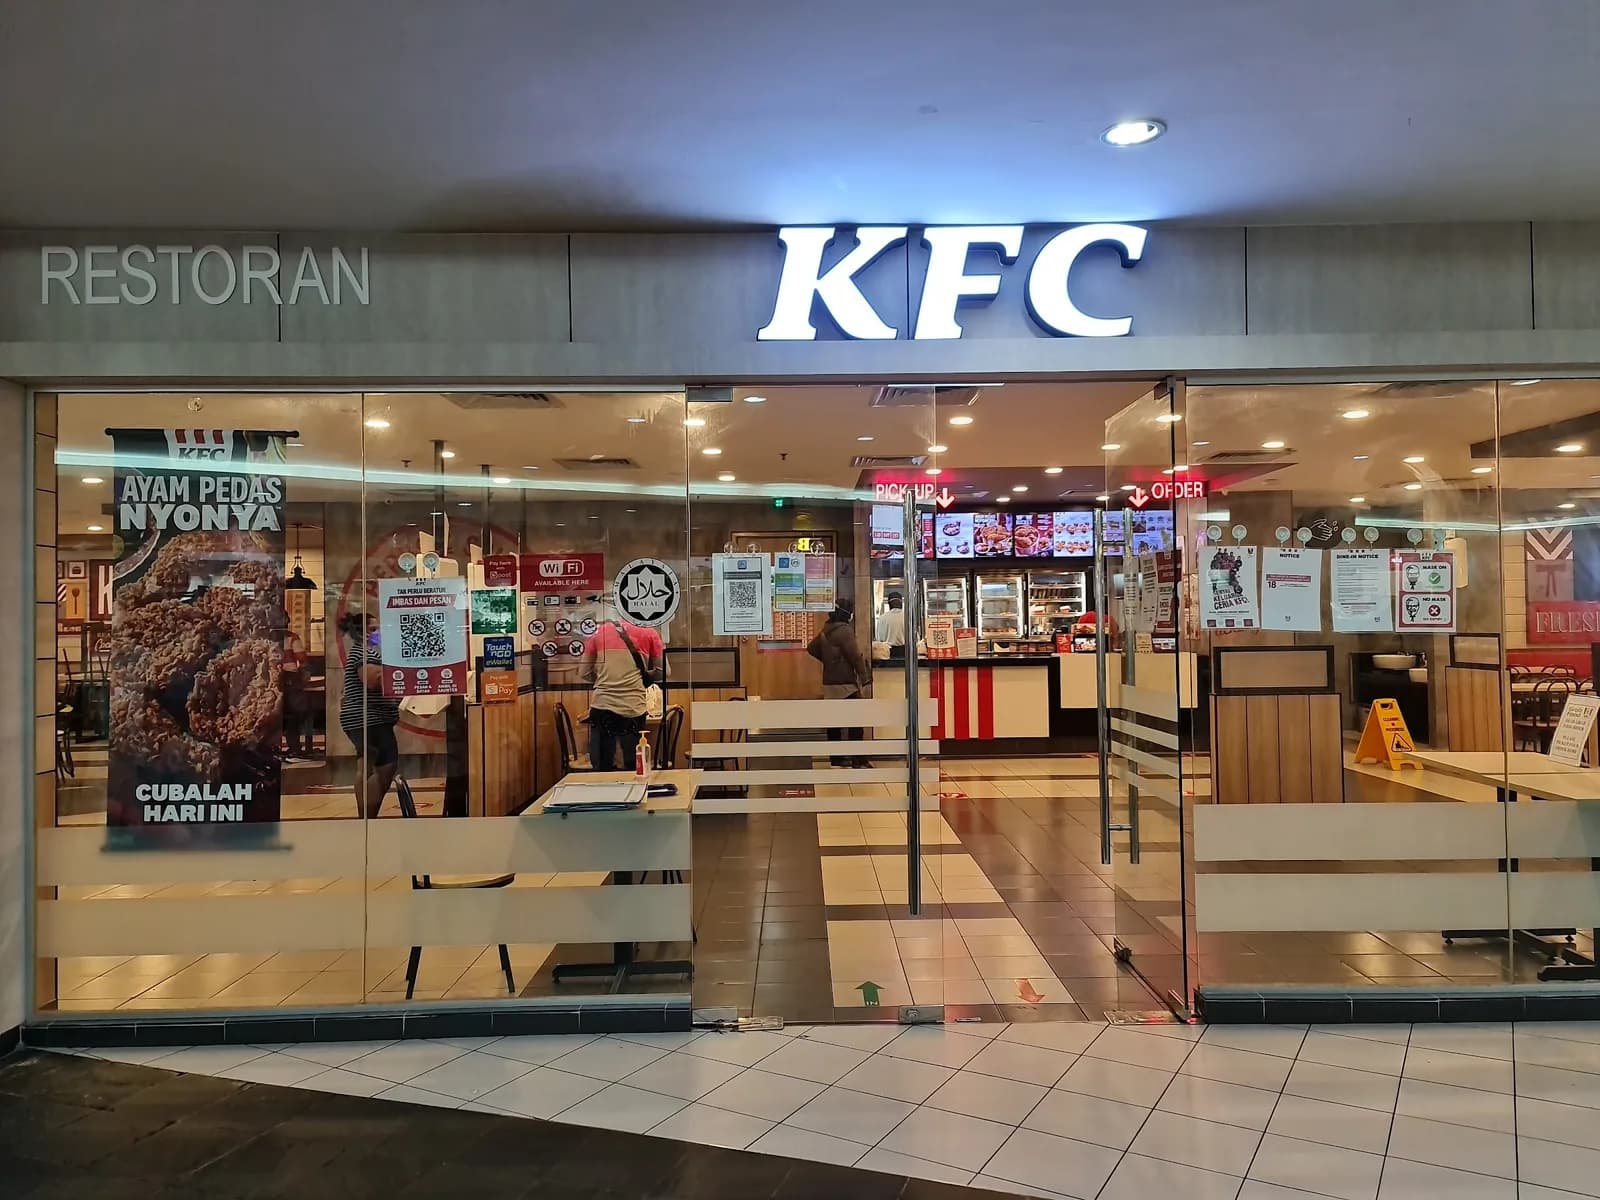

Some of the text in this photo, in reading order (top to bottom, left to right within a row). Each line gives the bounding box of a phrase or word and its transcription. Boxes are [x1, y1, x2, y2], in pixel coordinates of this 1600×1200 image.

[41, 245, 370, 305] RESTORAN
[757, 222, 1149, 342] KFC
[121, 475, 282, 503] AYAM PEDAS
[915, 484, 934, 500] UP
[120, 503, 281, 532] NYONYA
[626, 576, 670, 600] حلال
[1268, 581, 1277, 589] 18
[486, 643, 513, 651] Touch
[486, 658, 513, 666] eWallet
[498, 686, 514, 696] Pay
[135, 783, 253, 801] CUBALAH
[143, 804, 244, 822] HARI INI
